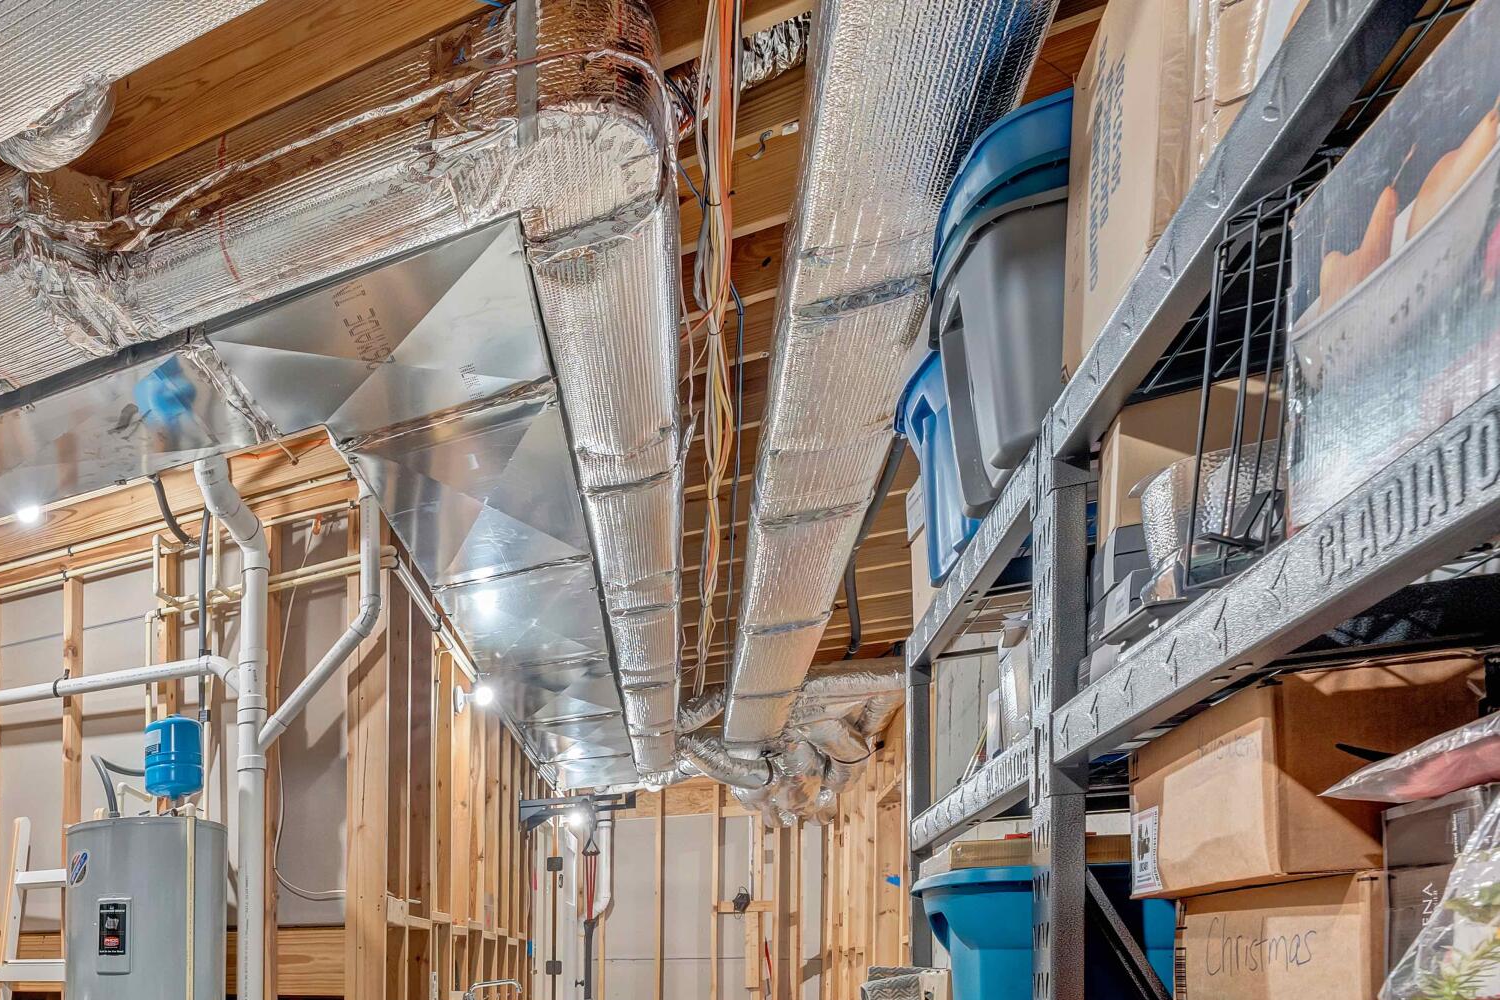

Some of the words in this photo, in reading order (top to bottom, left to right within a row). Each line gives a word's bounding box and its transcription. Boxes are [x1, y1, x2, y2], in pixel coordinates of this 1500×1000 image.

[1316, 404, 1500, 586] GLADIATO
[986, 747, 1028, 800] GLADIATOR
[1422, 882, 1433, 926] ENA
[1205, 916, 1317, 977] Christmas
